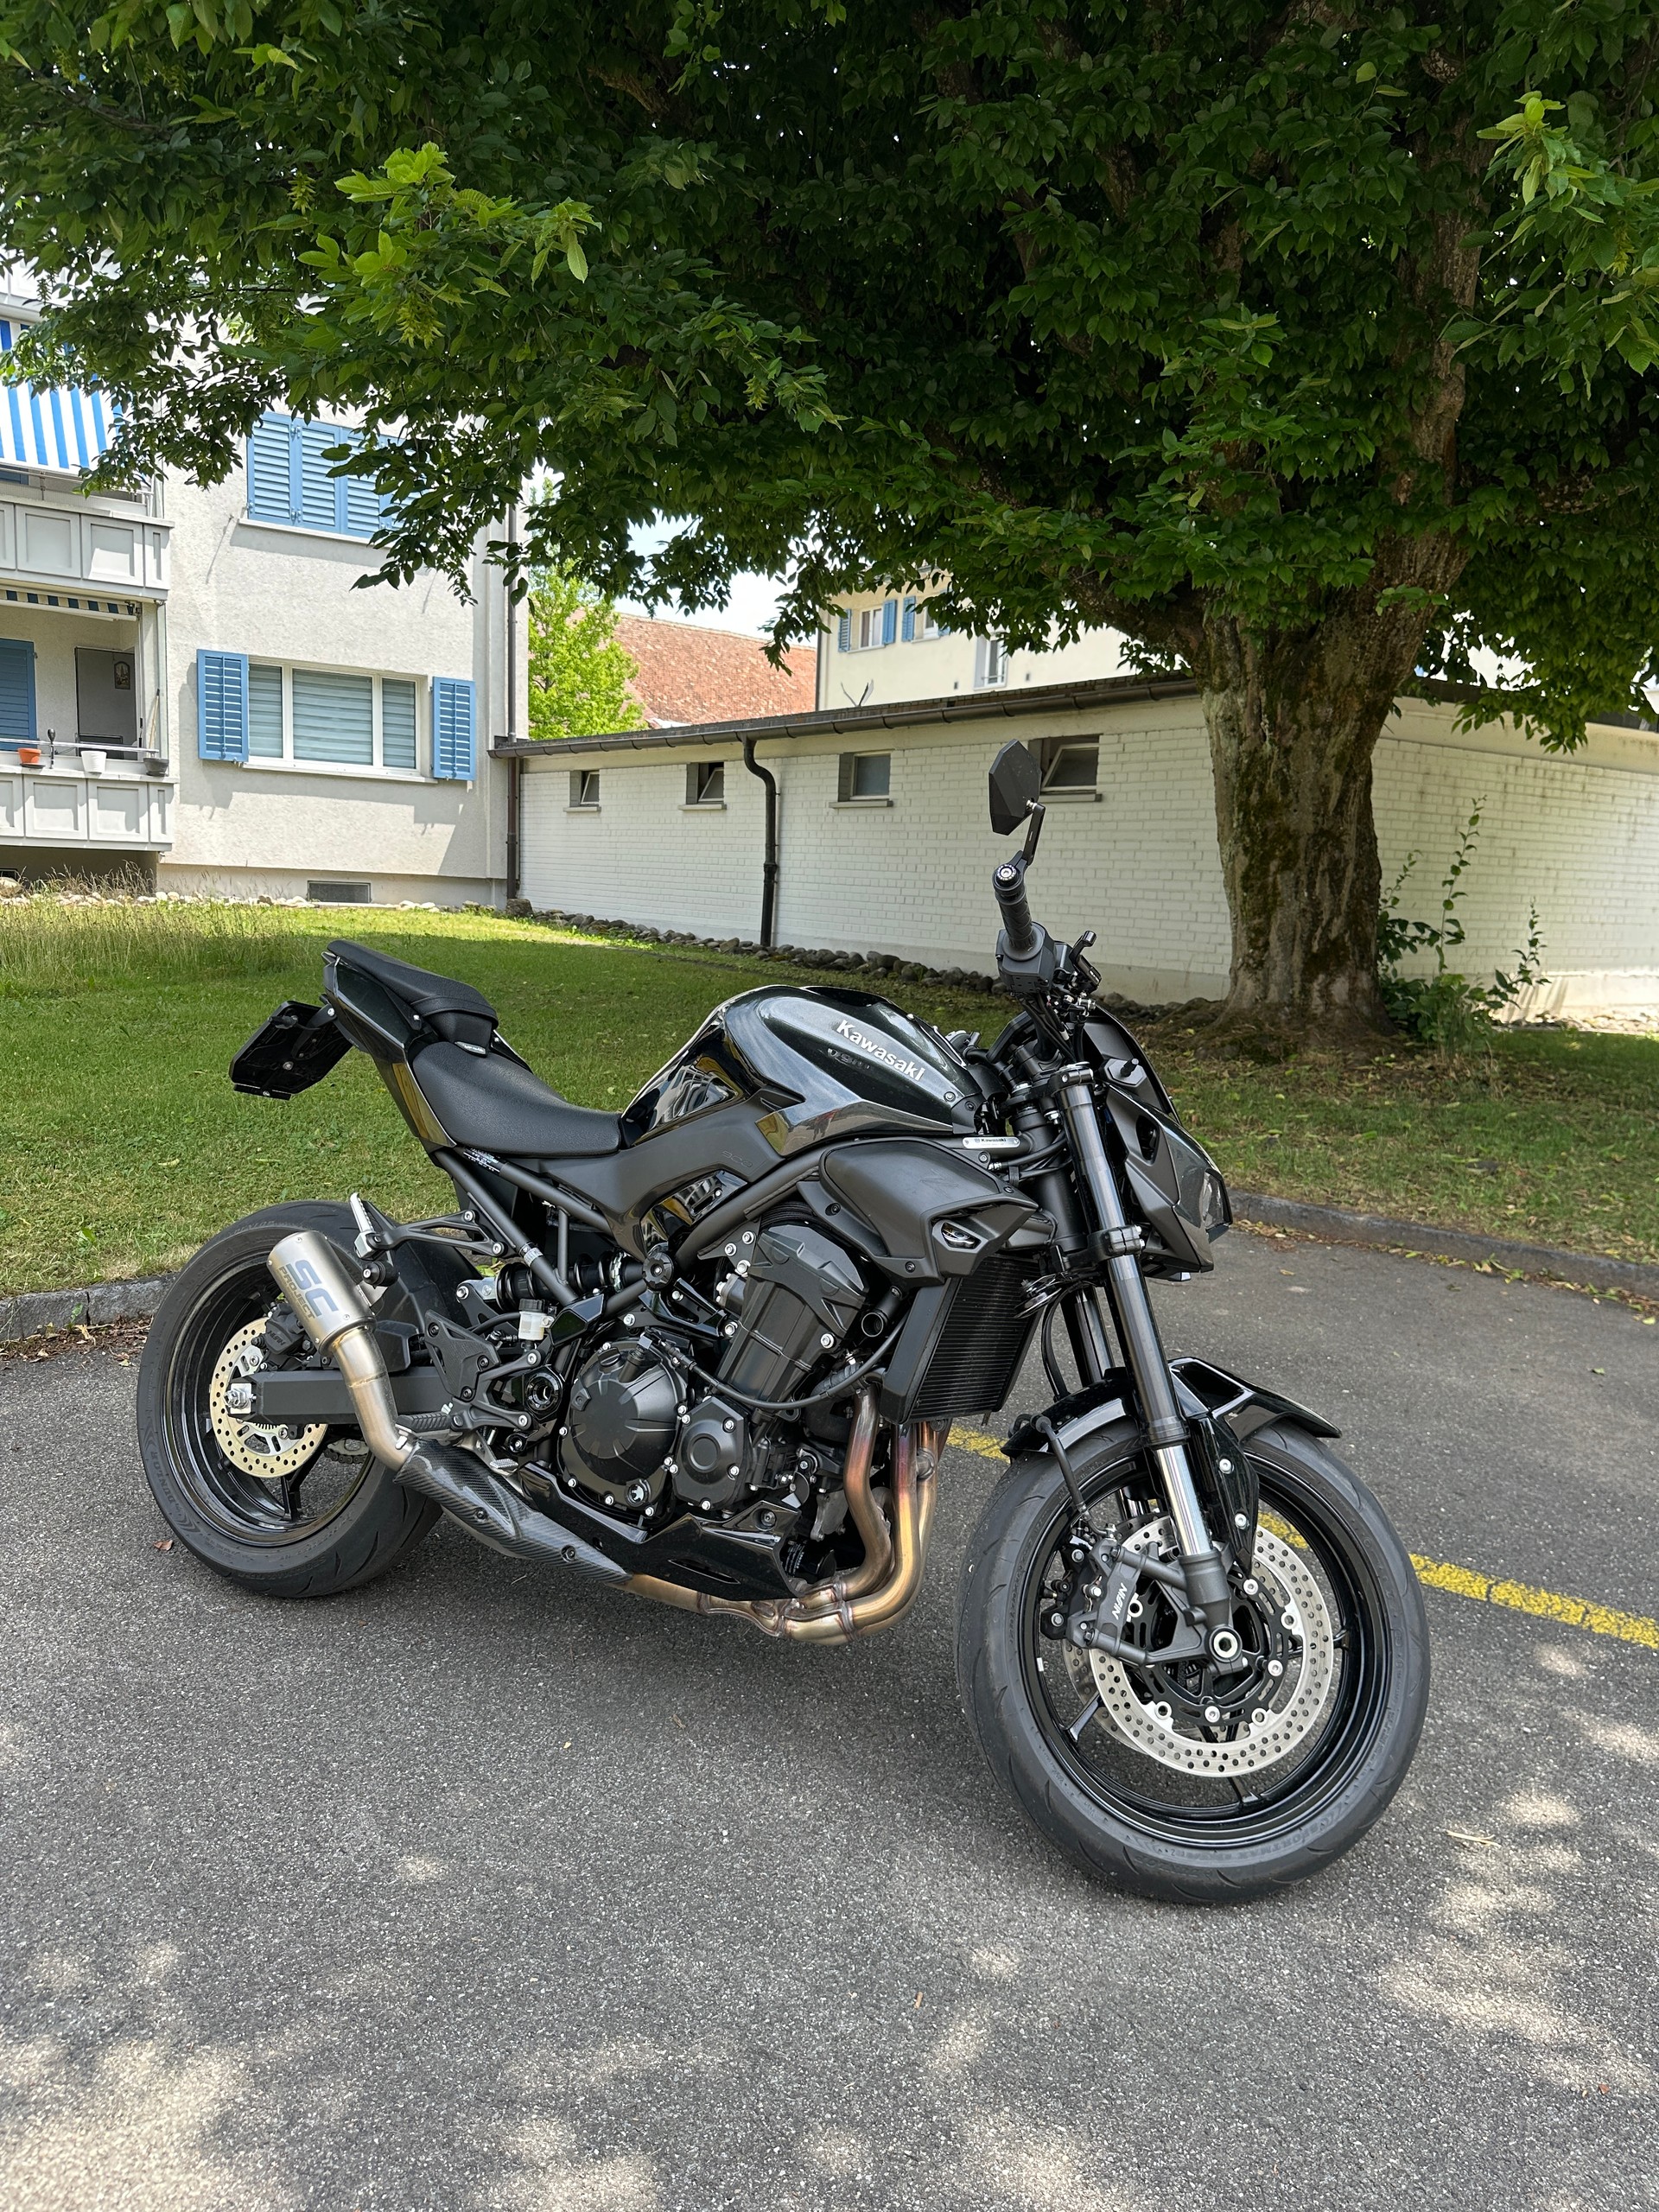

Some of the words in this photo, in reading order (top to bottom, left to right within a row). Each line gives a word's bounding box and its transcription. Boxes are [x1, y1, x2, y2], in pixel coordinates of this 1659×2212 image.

[836, 1020, 925, 1081] Kawasaki
[278, 1266, 315, 1319] PROJECT
[285, 1259, 340, 1317] SC
